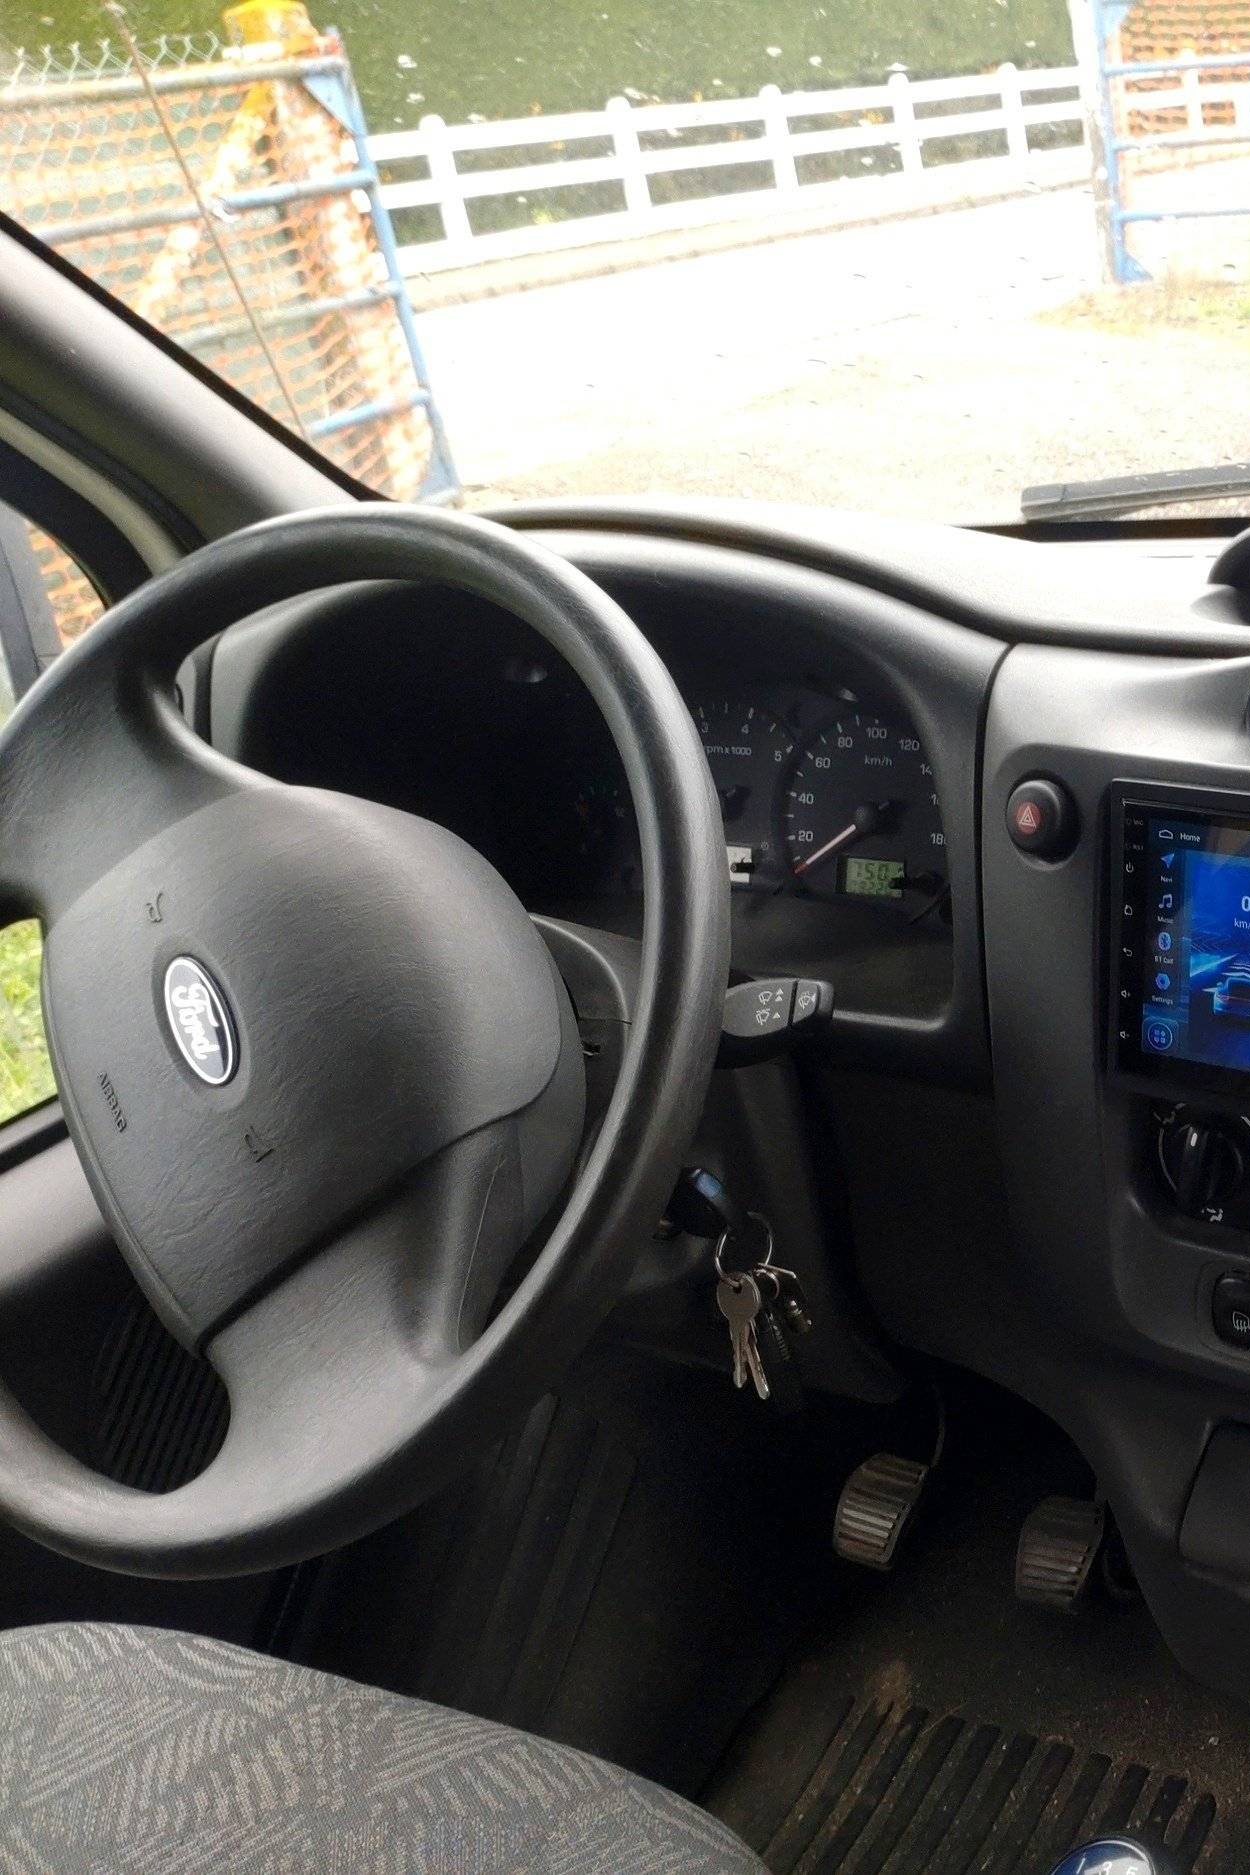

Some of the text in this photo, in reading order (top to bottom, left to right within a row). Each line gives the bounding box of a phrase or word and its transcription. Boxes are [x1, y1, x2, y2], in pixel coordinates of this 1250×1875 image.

[742, 723, 749, 734] 4
[866, 727, 887, 739] 100
[837, 736, 853, 748] 80
[899, 739, 920, 751] 120
[774, 750, 783, 762] 5
[864, 755, 893, 767] km/h
[815, 757, 831, 769] 60
[919, 763, 933, 776] 14
[799, 793, 814, 805] 40
[798, 830, 814, 842] 20
[930, 832, 945, 846] 18
[1180, 832, 1201, 842] Home
